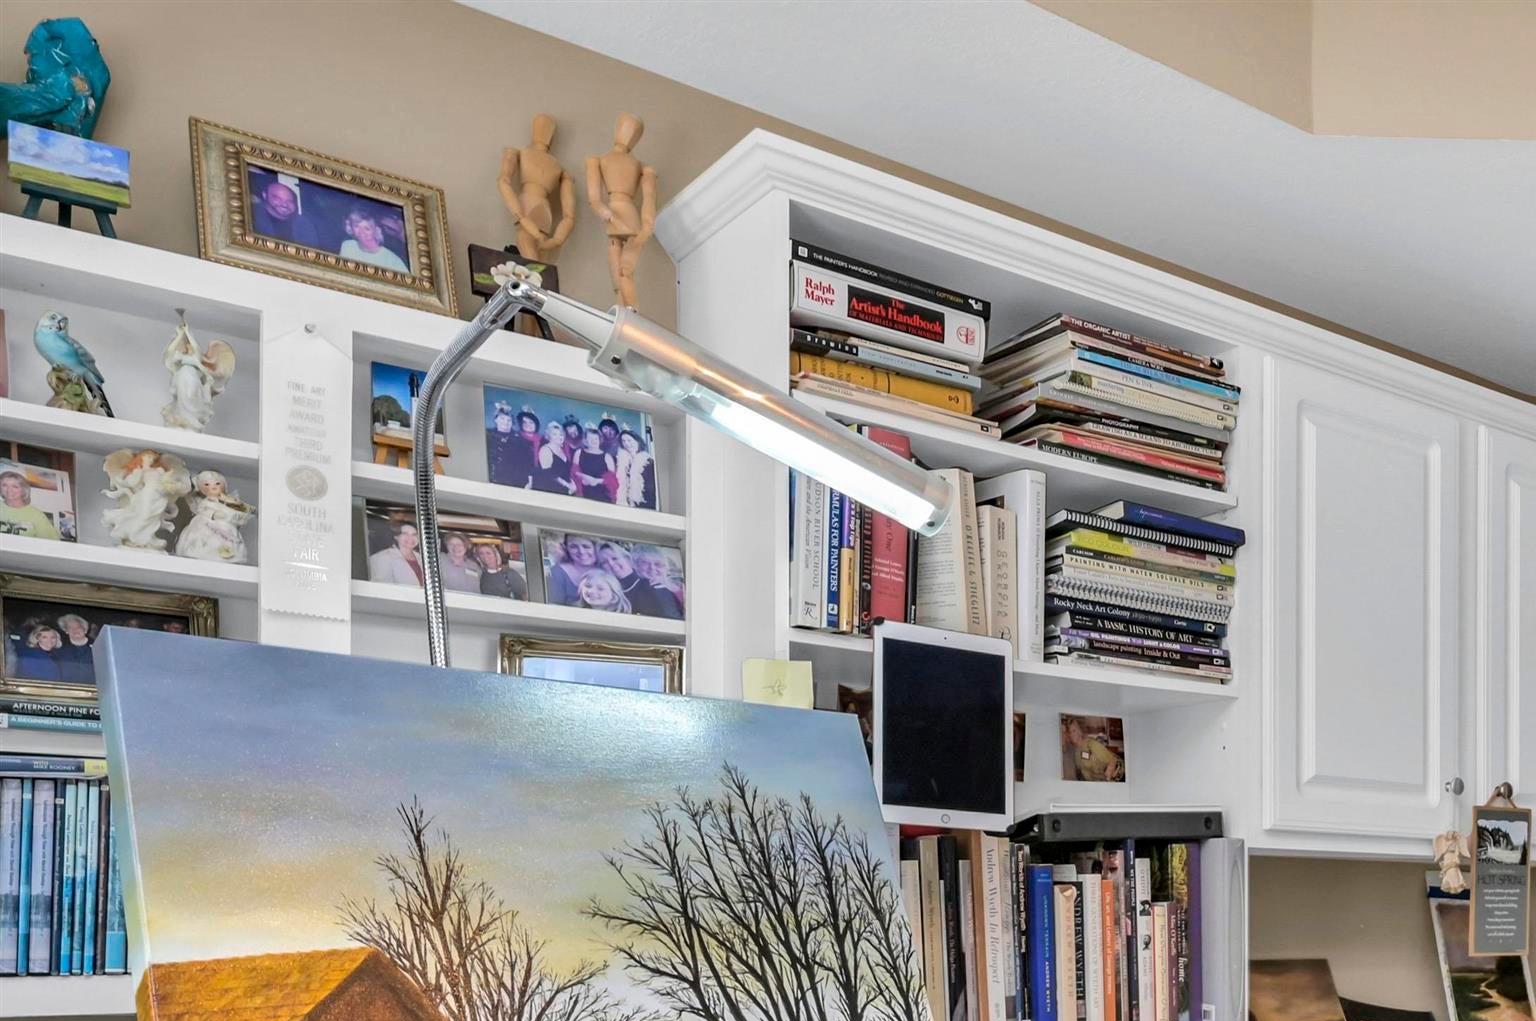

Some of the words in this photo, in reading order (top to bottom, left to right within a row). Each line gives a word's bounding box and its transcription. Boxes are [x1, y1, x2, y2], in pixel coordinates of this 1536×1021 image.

[813, 253, 823, 261] THE
[849, 263, 878, 278] HANDBOOK
[805, 277, 835, 295] Ralph
[805, 288, 835, 306] Mayer
[890, 298, 906, 309] The
[850, 297, 885, 317] Artist's
[888, 307, 943, 333] Handbook
[859, 312, 893, 328] MATERIALS
[1071, 319, 1083, 327] THE
[1084, 321, 1110, 335] ORGANIC
[1111, 329, 1131, 341] ARTIST
[310, 385, 326, 397] ART
[292, 395, 322, 410] MERIT
[289, 410, 325, 425] AWARD
[1101, 418, 1139, 430] PHOTOGRAPHY
[285, 447, 332, 465] PREMIUM
[1041, 445, 1072, 457] MODERN
[1074, 452, 1097, 463] EUROPE
[287, 503, 326, 520] SOUTH
[810, 517, 823, 547] RIVER
[830, 528, 840, 547] FOR
[810, 549, 822, 590] SCHOOL
[826, 547, 841, 591] PAINTERS
[1070, 557, 1106, 568] PAINTING
[1108, 564, 1126, 572] WITH
[1130, 569, 1153, 577] WATER
[1155, 573, 1186, 585] SOLUBLE
[1054, 598, 1075, 609] Rocky
[1077, 602, 1094, 612] Neck
[1107, 607, 1130, 618] Colony
[1096, 619, 1103, 628] A
[1104, 619, 1128, 632] BASIC
[1129, 625, 1164, 640] HISTORY
[1165, 632, 1177, 640] OF
[1178, 634, 1194, 643] ART
[1093, 640, 1119, 650] landscape
[1143, 647, 1161, 656] Inside
[1169, 651, 1181, 659] Out
[12, 703, 66, 712] AFTERNOON
[985, 848, 995, 883] Andrew
[987, 887, 997, 917] Wyeth
[1018, 911, 1026, 931] Wyeth
[1073, 888, 1084, 945] ANDREW
[989, 922, 997, 932] In
[988, 934, 1000, 984] Retrospect
[1075, 949, 1085, 996] WYETH
[1177, 957, 1188, 982] home
